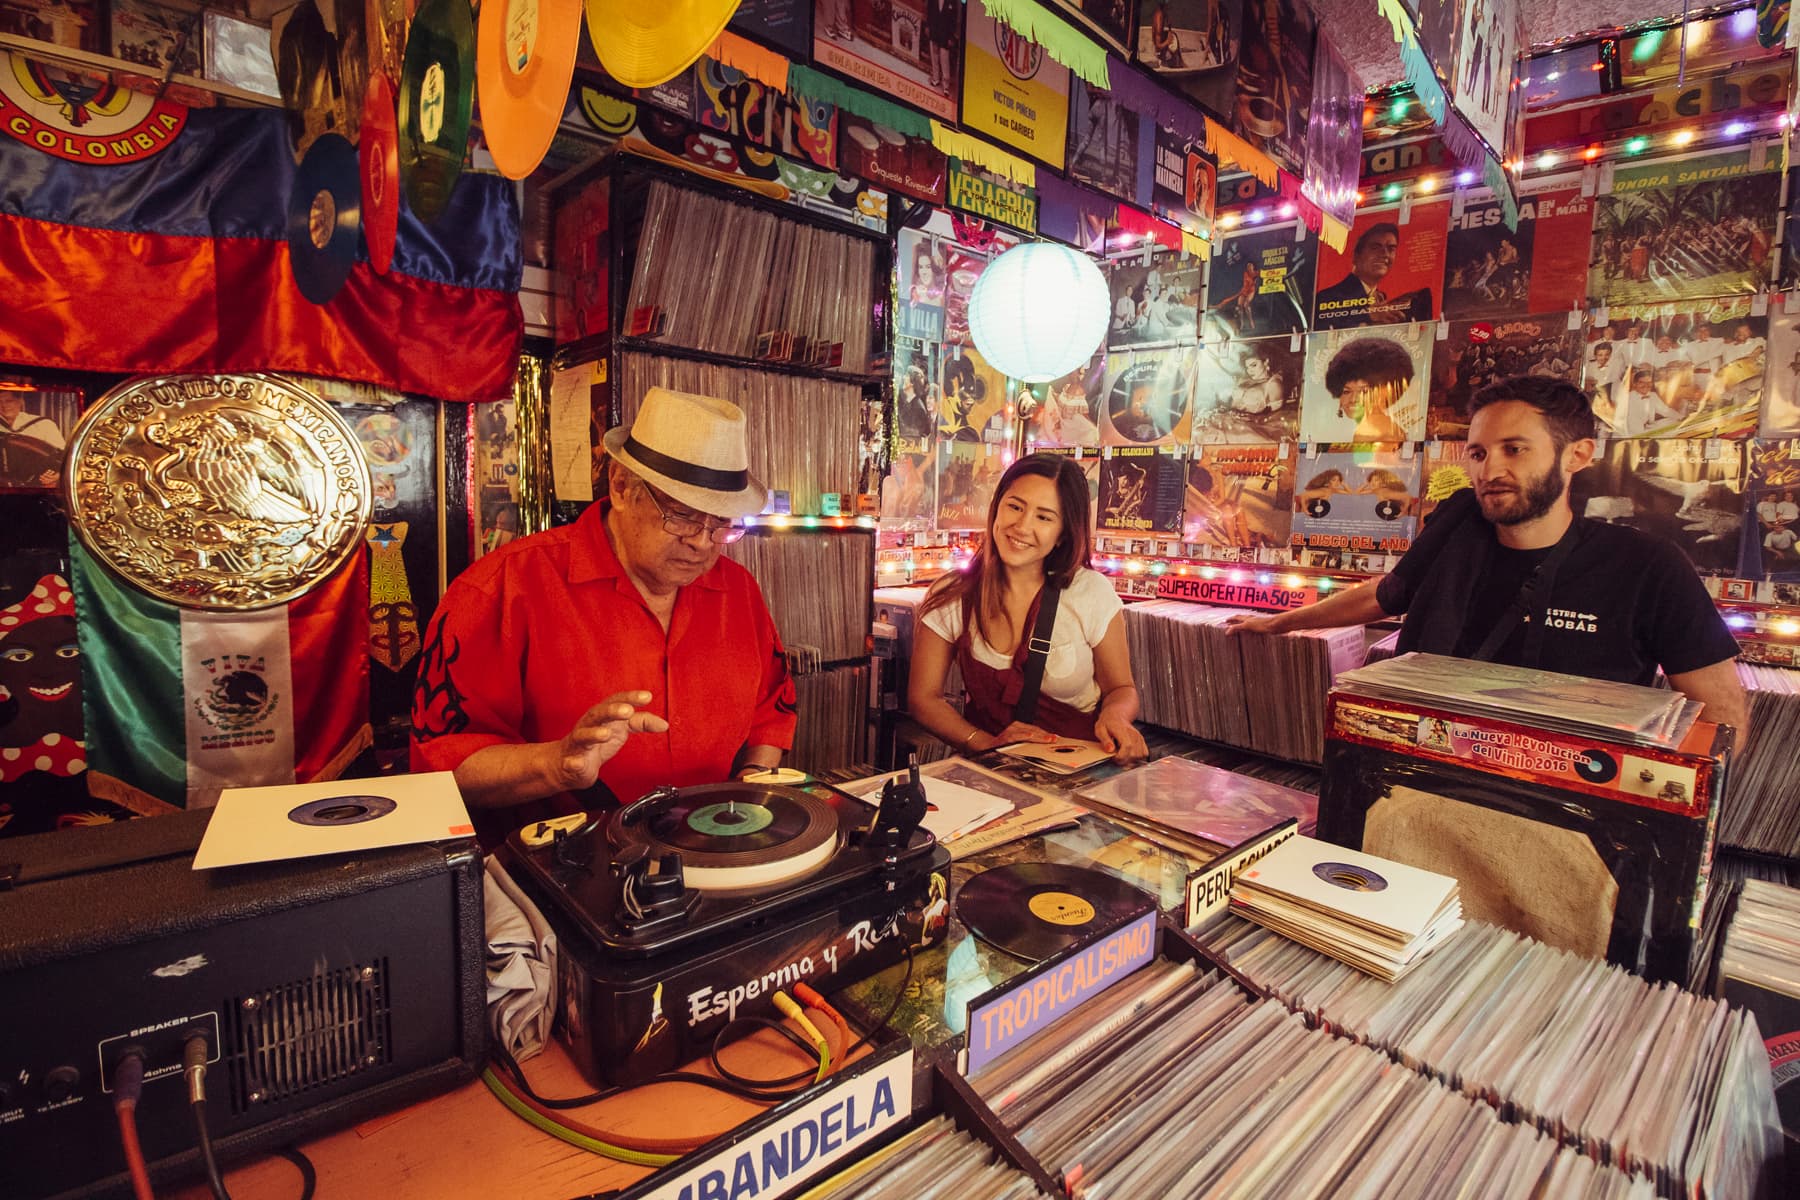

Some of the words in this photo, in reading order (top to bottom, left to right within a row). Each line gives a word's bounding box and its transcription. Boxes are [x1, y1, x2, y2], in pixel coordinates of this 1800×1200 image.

[10, 112, 179, 159] COLOMBIA
[870, 161, 903, 185] Orquesta
[905, 174, 938, 196] Riverside
[1678, 159, 1775, 182] SANTANA
[950, 170, 1037, 234] VERACRUZ
[1538, 208, 1553, 219] EL
[1556, 203, 1588, 217] MAR
[1448, 202, 1536, 232] FIESA
[1539, 199, 1555, 210] EN
[1319, 310, 1349, 319] CUCO
[1320, 297, 1376, 311] BOLEROS
[80, 394, 155, 484] ESTADOS
[150, 378, 255, 407] UNIDOS
[260, 388, 359, 492] MEXICANOS
[1292, 533, 1307, 546] EL
[1309, 533, 1349, 548] DISCO
[1351, 536, 1376, 550] DEL
[1379, 534, 1410, 552] AÑO
[1158, 578, 1199, 598] SUPER
[1544, 615, 1598, 633] AOBAB
[200, 729, 275, 750] MEXICO
[1454, 729, 1468, 738] La
[1470, 730, 1512, 745] Nueva
[1513, 733, 1593, 765] Revolución
[1472, 743, 1492, 757] del
[1494, 748, 1534, 769] Vinilo
[1535, 757, 1568, 772] 2016
[1196, 865, 1234, 915] PERU
[687, 956, 815, 1028] Esperma
[823, 945, 838, 974] y
[980, 921, 1151, 1051] TROPICALISIMO
[130, 1016, 189, 1038] SPEAKER
[143, 1063, 183, 1078] 4ohms
